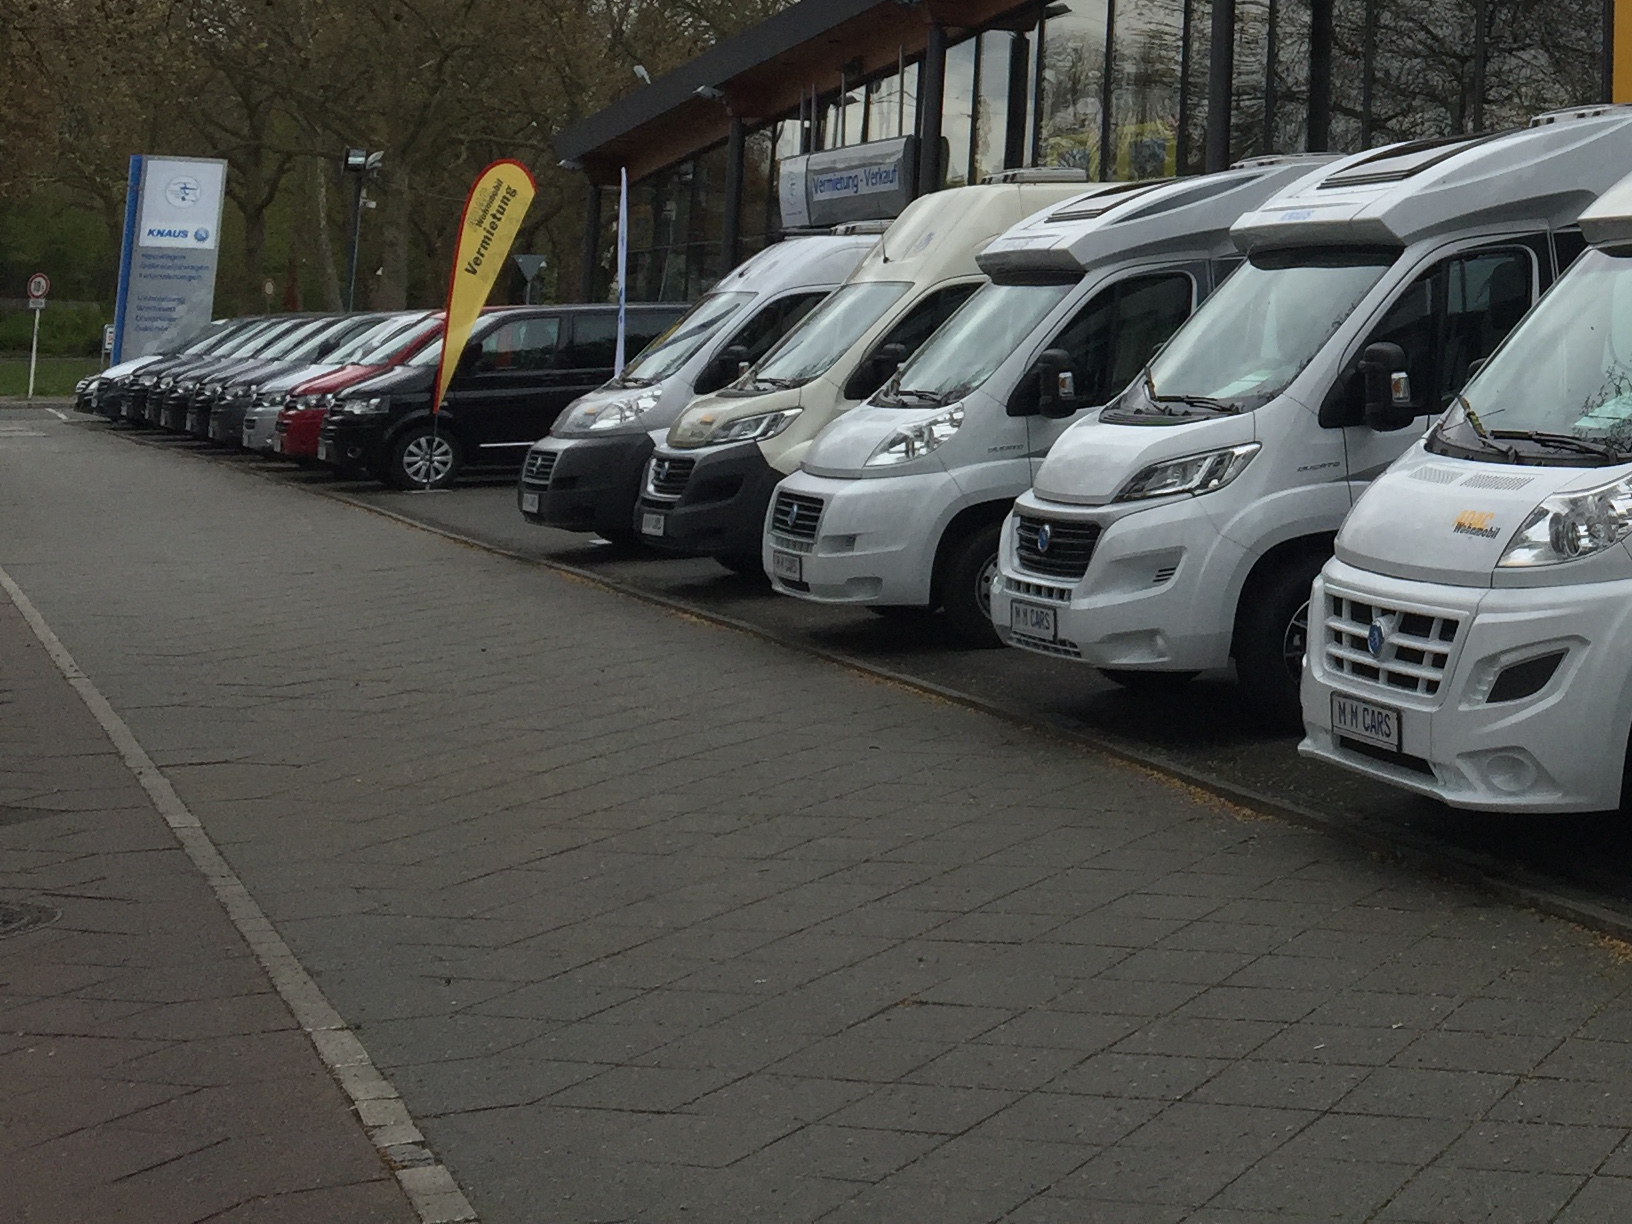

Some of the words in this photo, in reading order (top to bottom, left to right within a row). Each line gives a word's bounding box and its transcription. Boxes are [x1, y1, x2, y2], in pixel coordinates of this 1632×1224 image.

[863, 164, 897, 187] Verkauf
[147, 228, 189, 239] KNAUS
[464, 184, 519, 276] Vermietung
[1362, 707, 1392, 738] CARS
